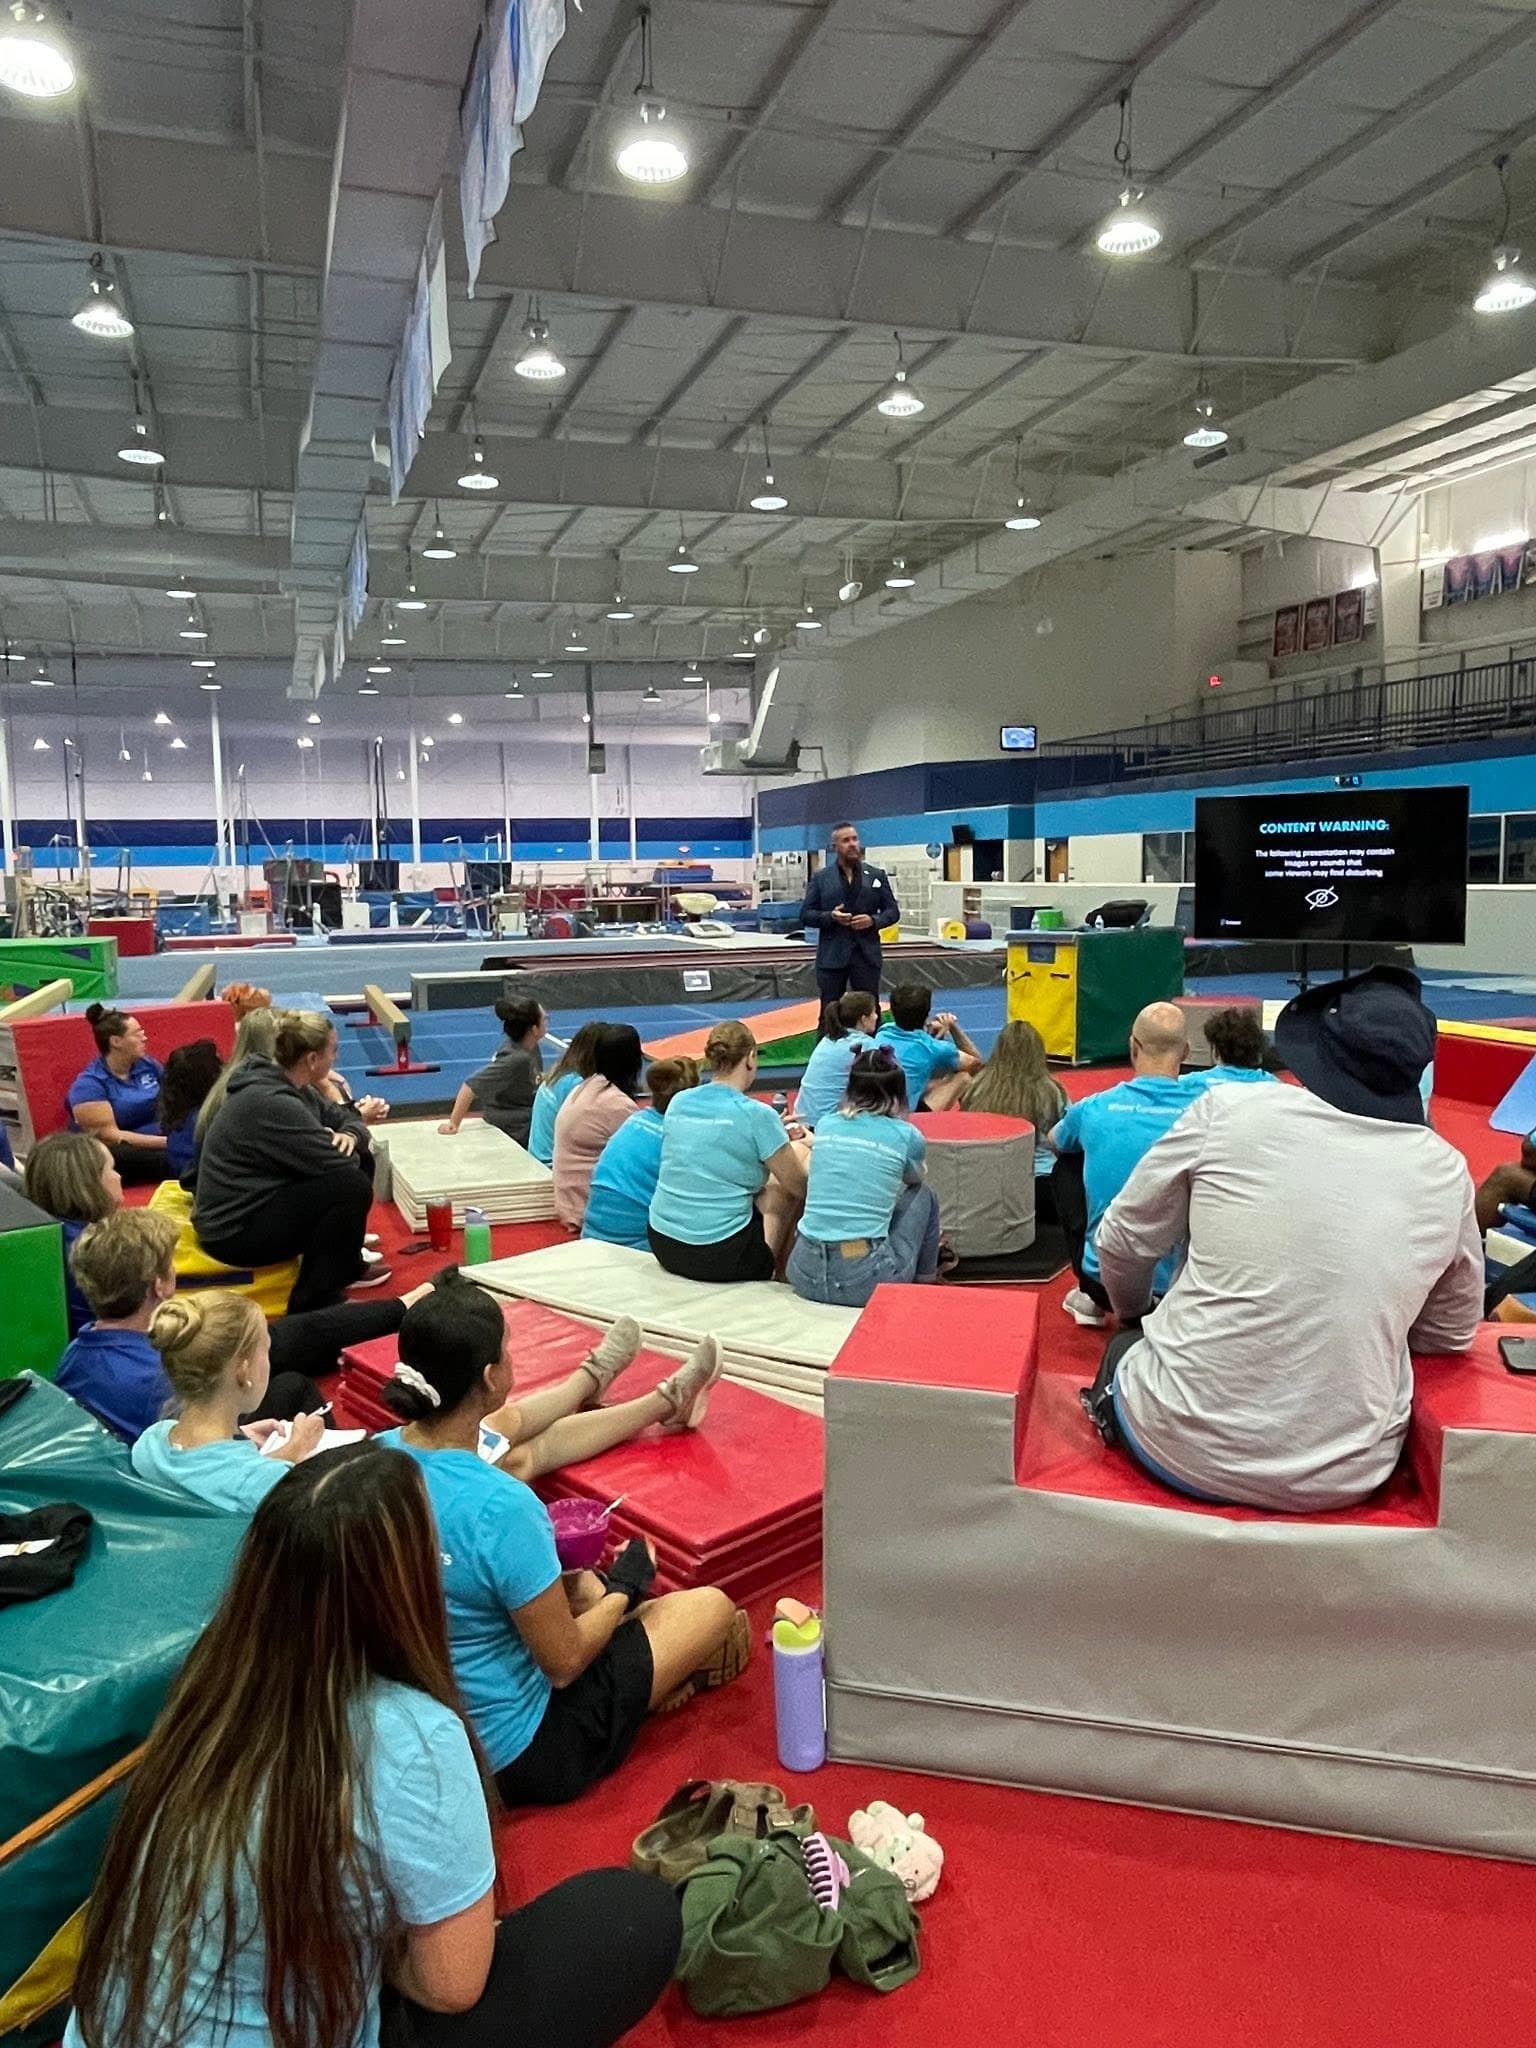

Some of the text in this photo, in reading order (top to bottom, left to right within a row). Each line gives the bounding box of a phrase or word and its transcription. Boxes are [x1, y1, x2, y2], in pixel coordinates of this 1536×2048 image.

[1259, 819, 1390, 834] CONTENT WARNING:
[1256, 848, 1395, 858] The following presentation may contain
[1345, 868, 1384, 878] disturbing
